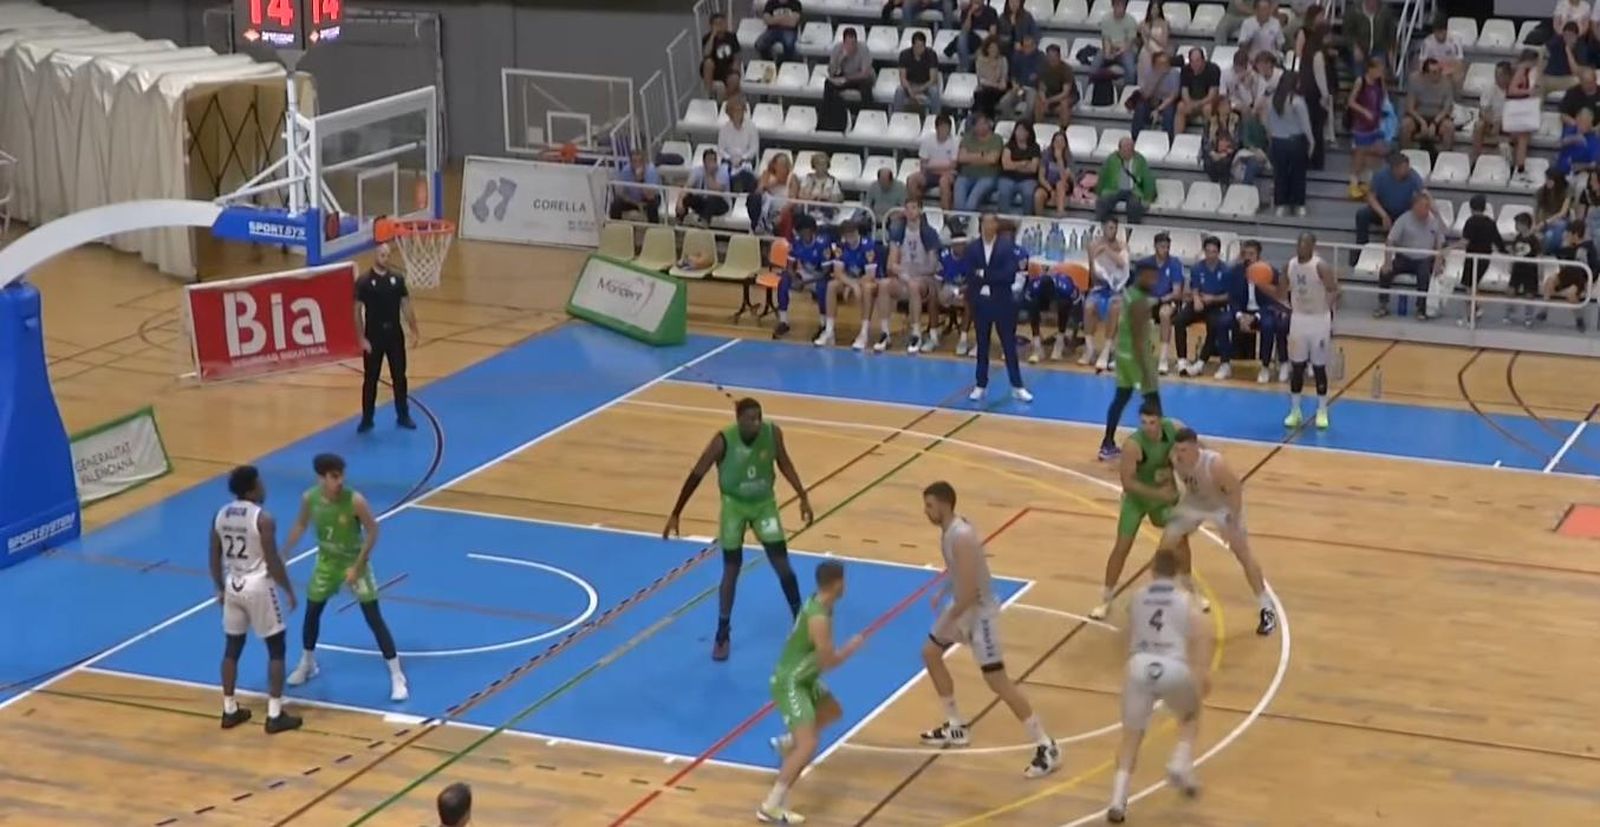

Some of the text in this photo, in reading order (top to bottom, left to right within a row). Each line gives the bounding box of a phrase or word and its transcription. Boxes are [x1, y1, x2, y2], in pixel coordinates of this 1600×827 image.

[533, 198, 587, 212] CORELLA
[223, 291, 327, 357] Bia
[326, 527, 334, 540] 7
[223, 534, 249, 560] 22
[1148, 608, 1164, 632] 4
